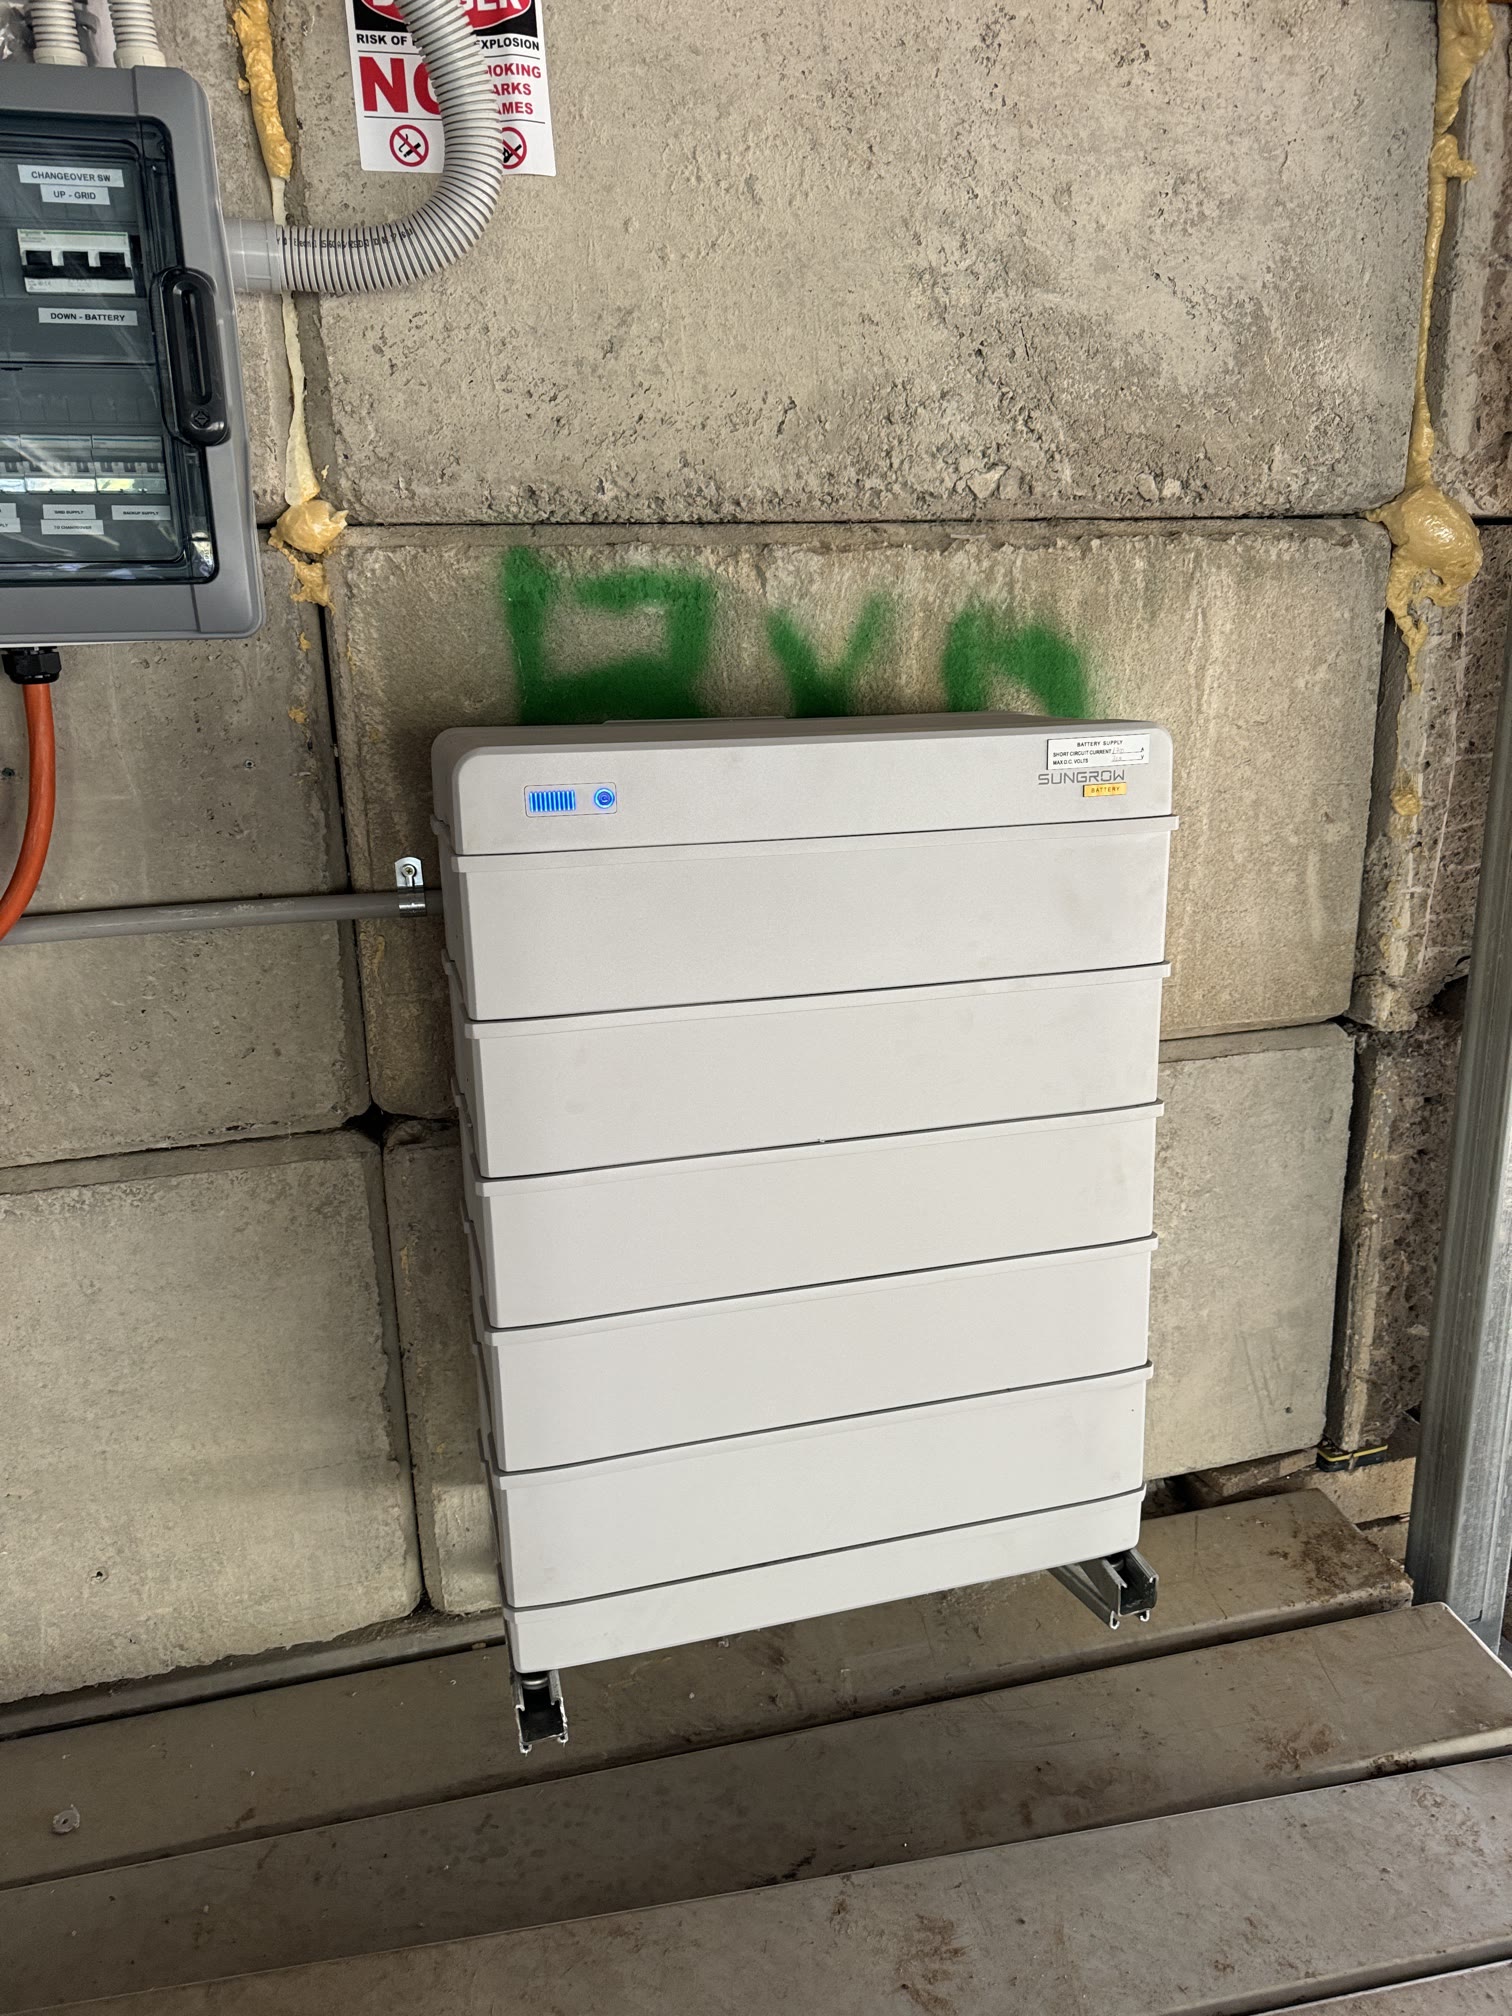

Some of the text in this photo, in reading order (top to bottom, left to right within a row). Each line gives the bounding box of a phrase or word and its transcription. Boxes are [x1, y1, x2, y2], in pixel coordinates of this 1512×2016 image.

[356, 33, 387, 45] RISK
[391, 35, 407, 46] OF
[486, 63, 541, 79] OKING
[492, 82, 532, 96] ARKS
[31, 170, 111, 183] CHANGEOVER SW
[53, 190, 66, 199] UP
[74, 191, 96, 200] GRID
[50, 312, 77, 321] DOWN
[85, 313, 125, 322] BATTERY
[1038, 769, 1125, 785] SUNGROW
